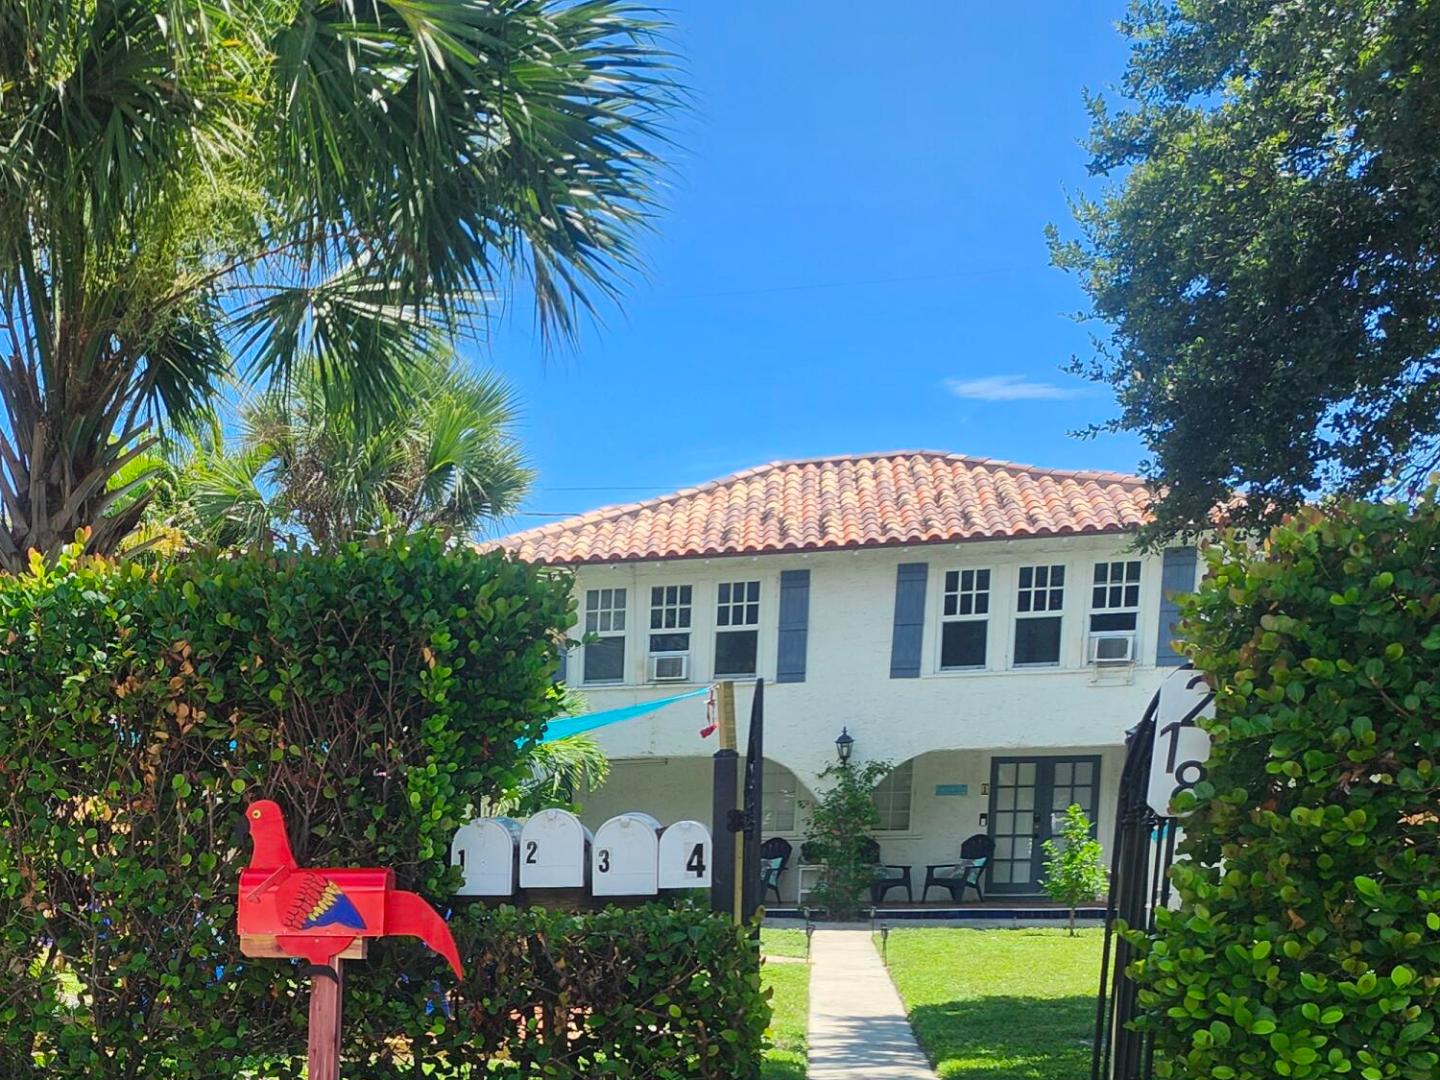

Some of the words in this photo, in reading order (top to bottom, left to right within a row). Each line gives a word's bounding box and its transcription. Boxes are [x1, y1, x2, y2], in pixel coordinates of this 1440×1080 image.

[458, 849, 465, 871] 1
[526, 841, 538, 864] 2
[598, 849, 610, 873] 3
[686, 843, 706, 878] 4
